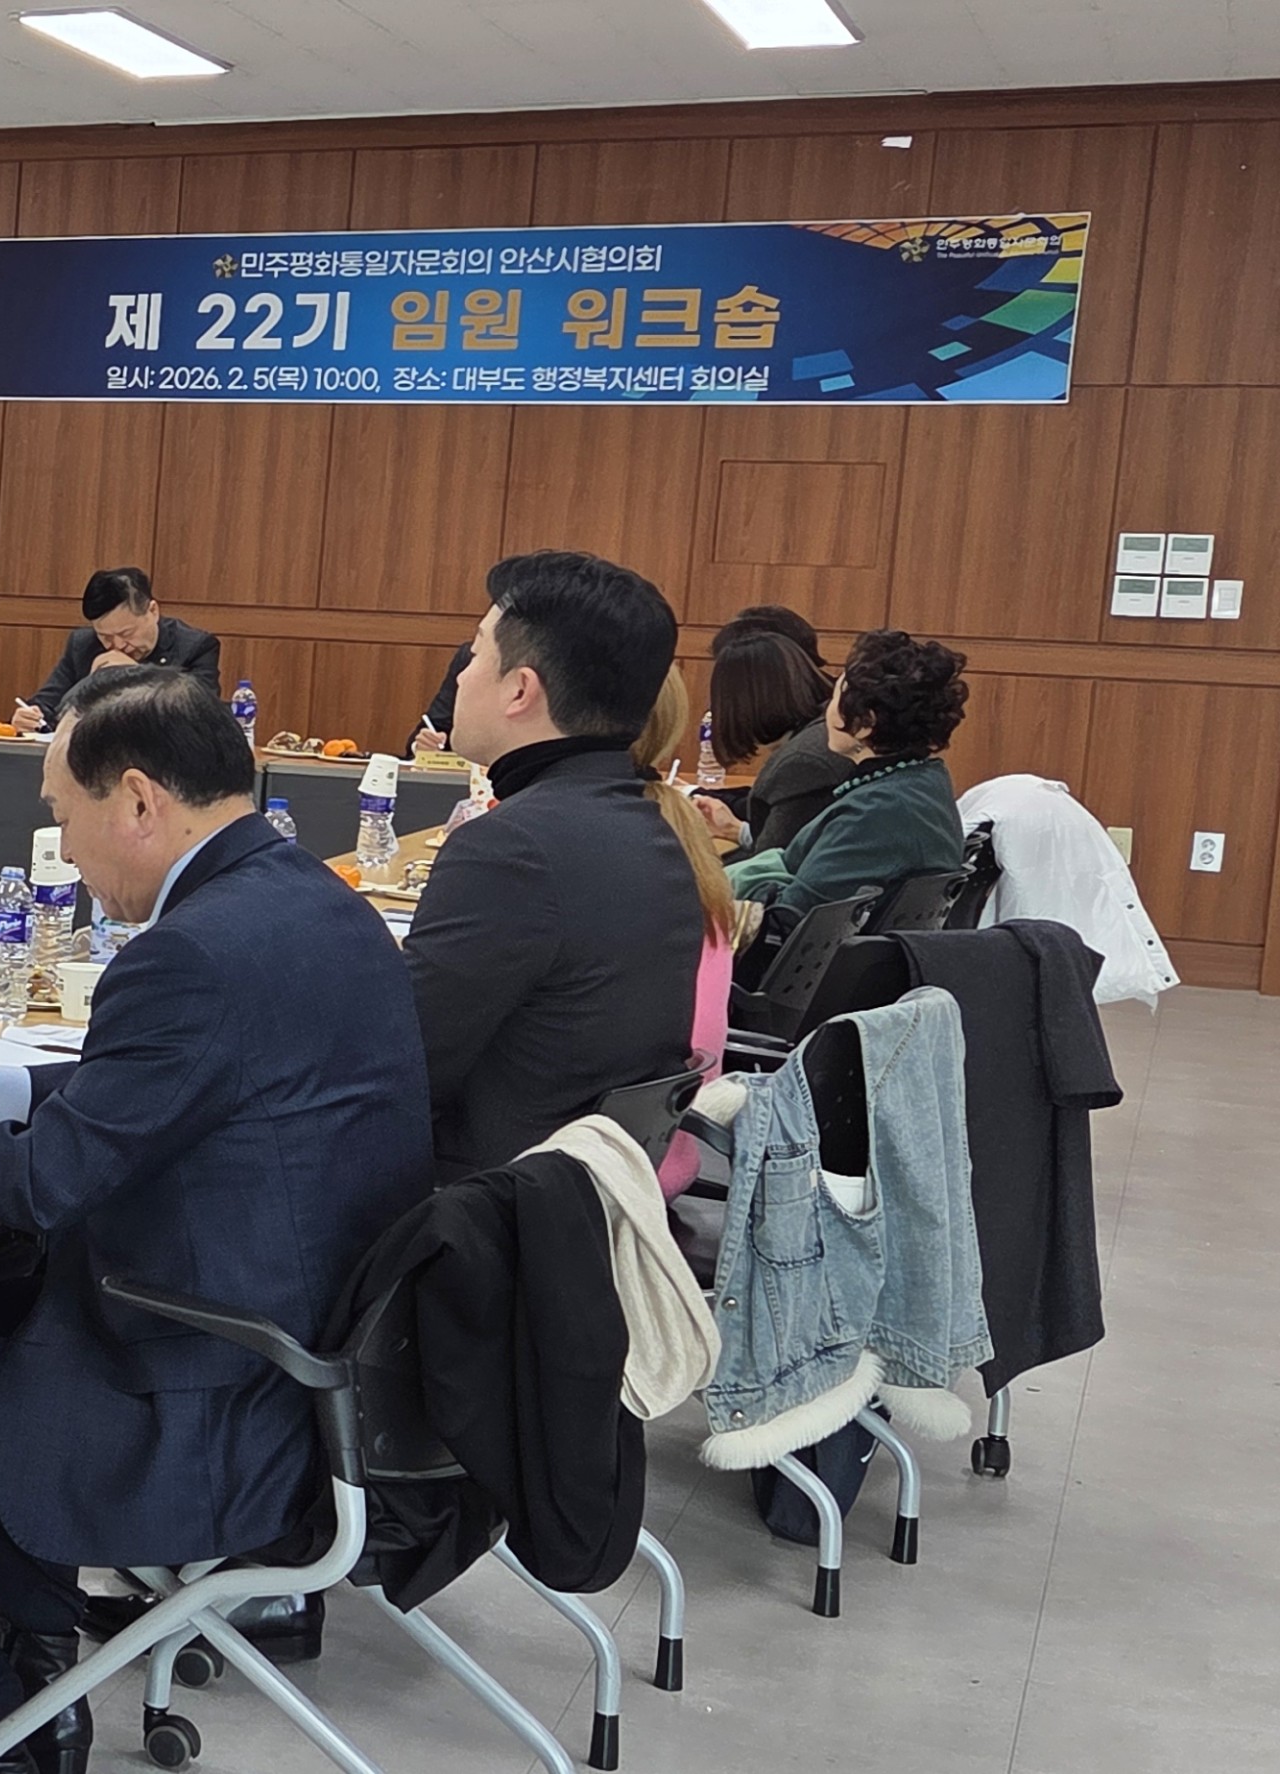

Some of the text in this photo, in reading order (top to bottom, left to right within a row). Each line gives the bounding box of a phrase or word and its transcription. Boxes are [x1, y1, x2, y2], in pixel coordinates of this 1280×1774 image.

[240, 245, 663, 278] 민주평화통일자문회의 안산시협의회
[105, 284, 781, 351] 제 22기 임원 워크숍
[106, 365, 770, 393] 일시: 2026. 2. 5(목) 10:00, 장소: 대부도 행정복지센터 회의실
